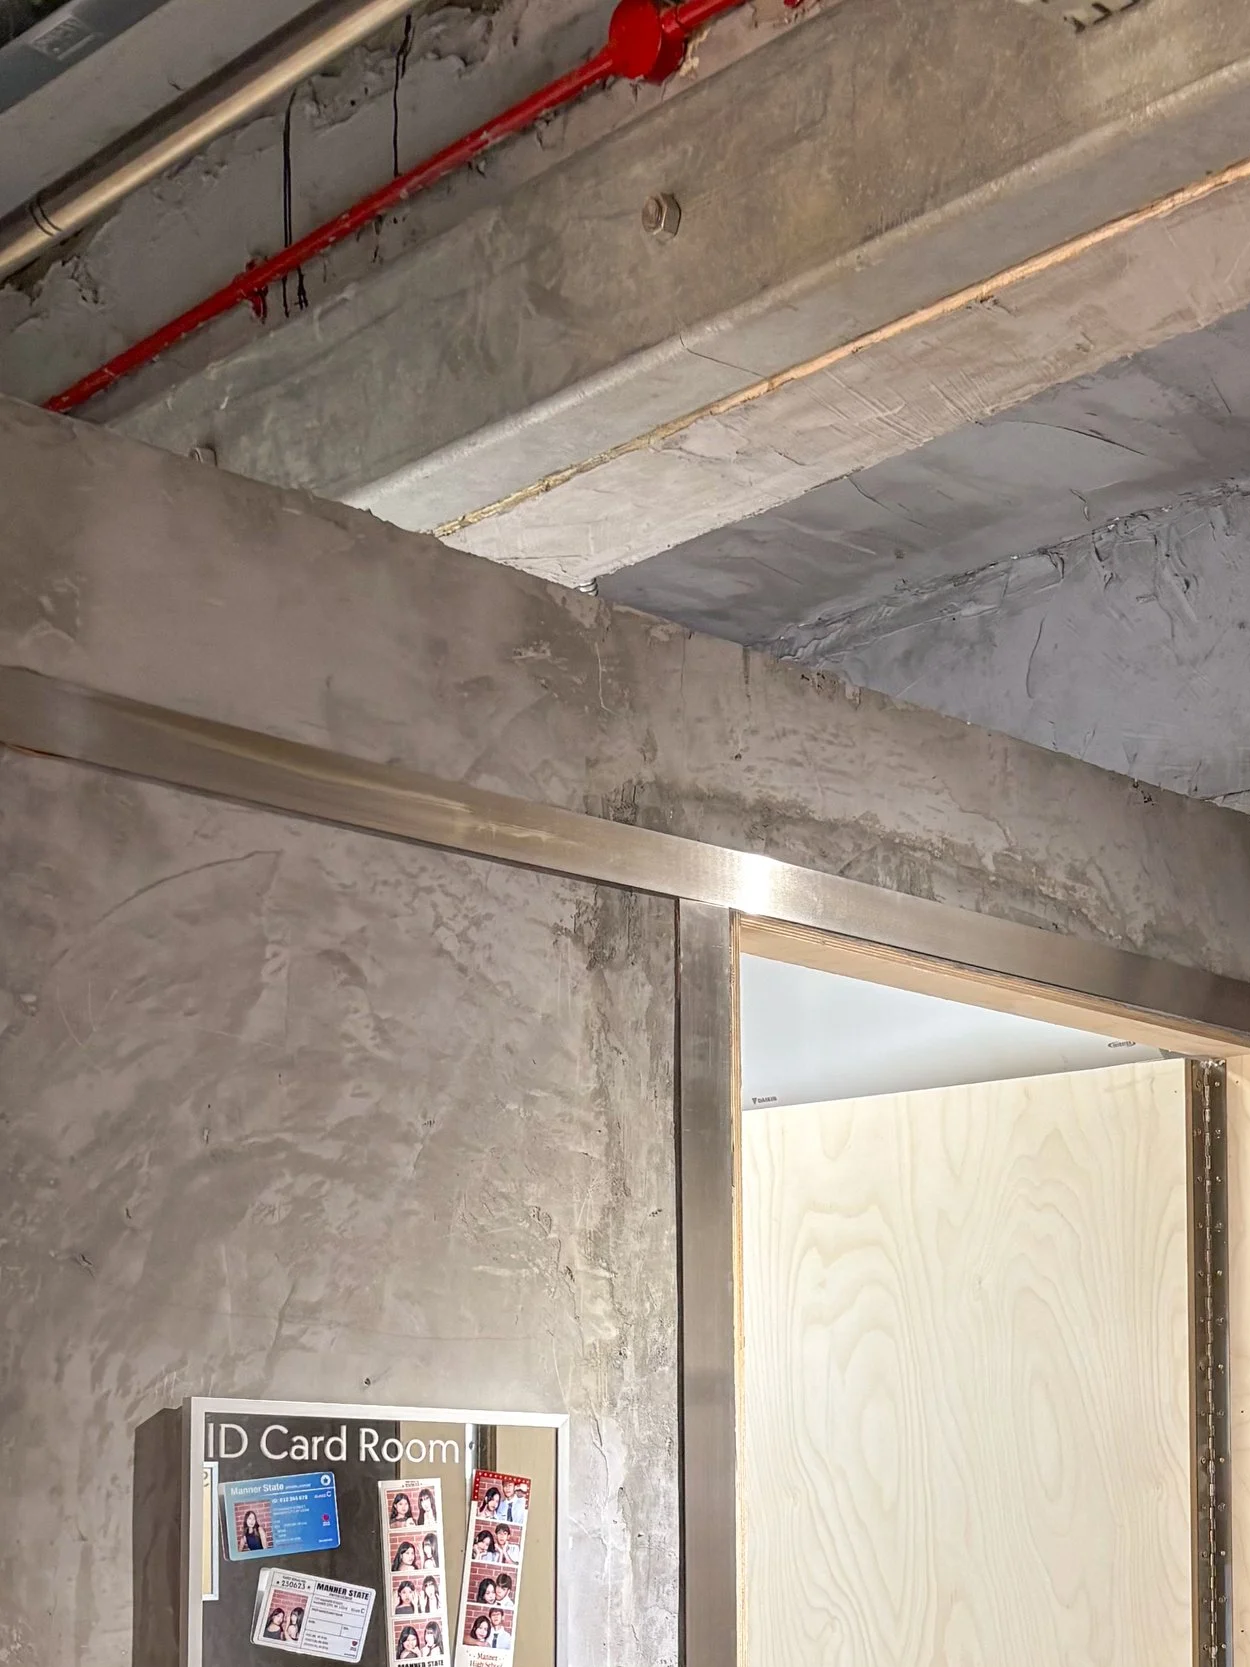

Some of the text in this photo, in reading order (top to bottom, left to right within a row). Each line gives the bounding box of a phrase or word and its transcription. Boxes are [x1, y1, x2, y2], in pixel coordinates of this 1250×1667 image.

[207, 1422, 460, 1464] ID Card Room
[230, 1486, 261, 1496] Manner
[262, 1483, 285, 1493] State
[316, 1582, 348, 1596] MANNER
[348, 1589, 370, 1600] STATE
[427, 1659, 444, 1667] STATE
[477, 1652, 498, 1661] Manner
